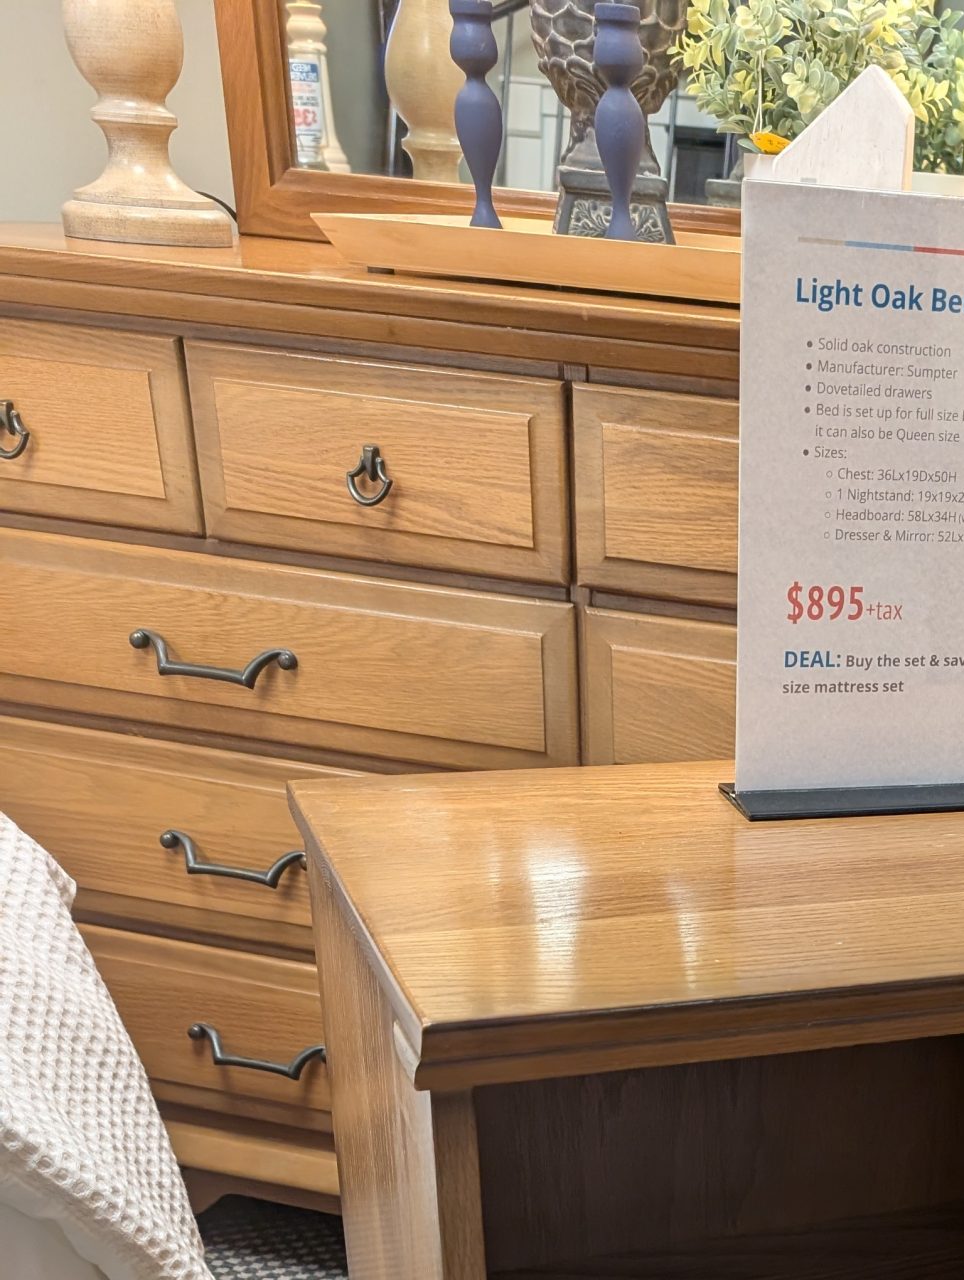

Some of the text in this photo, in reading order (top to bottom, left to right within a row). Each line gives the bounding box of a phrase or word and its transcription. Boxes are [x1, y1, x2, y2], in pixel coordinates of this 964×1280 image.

[796, 277, 864, 313] Light
[871, 283, 924, 312] Oak
[818, 337, 951, 358] Solid oak construction
[817, 359, 958, 382] Manufacturer: Sumpter
[817, 381, 933, 400] Dovetailed drawers
[816, 403, 840, 417] Bed
[842, 404, 852, 417] is
[855, 407, 874, 418] set
[876, 408, 893, 422] up
[895, 406, 913, 420] for
[916, 407, 934, 421] full
[937, 409, 959, 422] size
[815, 424, 960, 443] it can also be Queen size
[814, 445, 847, 459] Sizes:
[837, 467, 957, 483] Chest: 36Lx19Dx50H
[837, 487, 842, 500] 1
[847, 488, 914, 504] Nightstand:
[836, 508, 905, 522] Headboard:
[907, 510, 957, 523] 58Lx34H
[835, 528, 881, 541] Dresser
[882, 529, 892, 542] &
[895, 529, 935, 542] Mirror:
[784, 650, 842, 668] DEAL:
[845, 654, 874, 672] Buy
[876, 653, 901, 668] the
[904, 655, 926, 668] set
[929, 654, 940, 667] &
[782, 680, 905, 694] size mattress set
